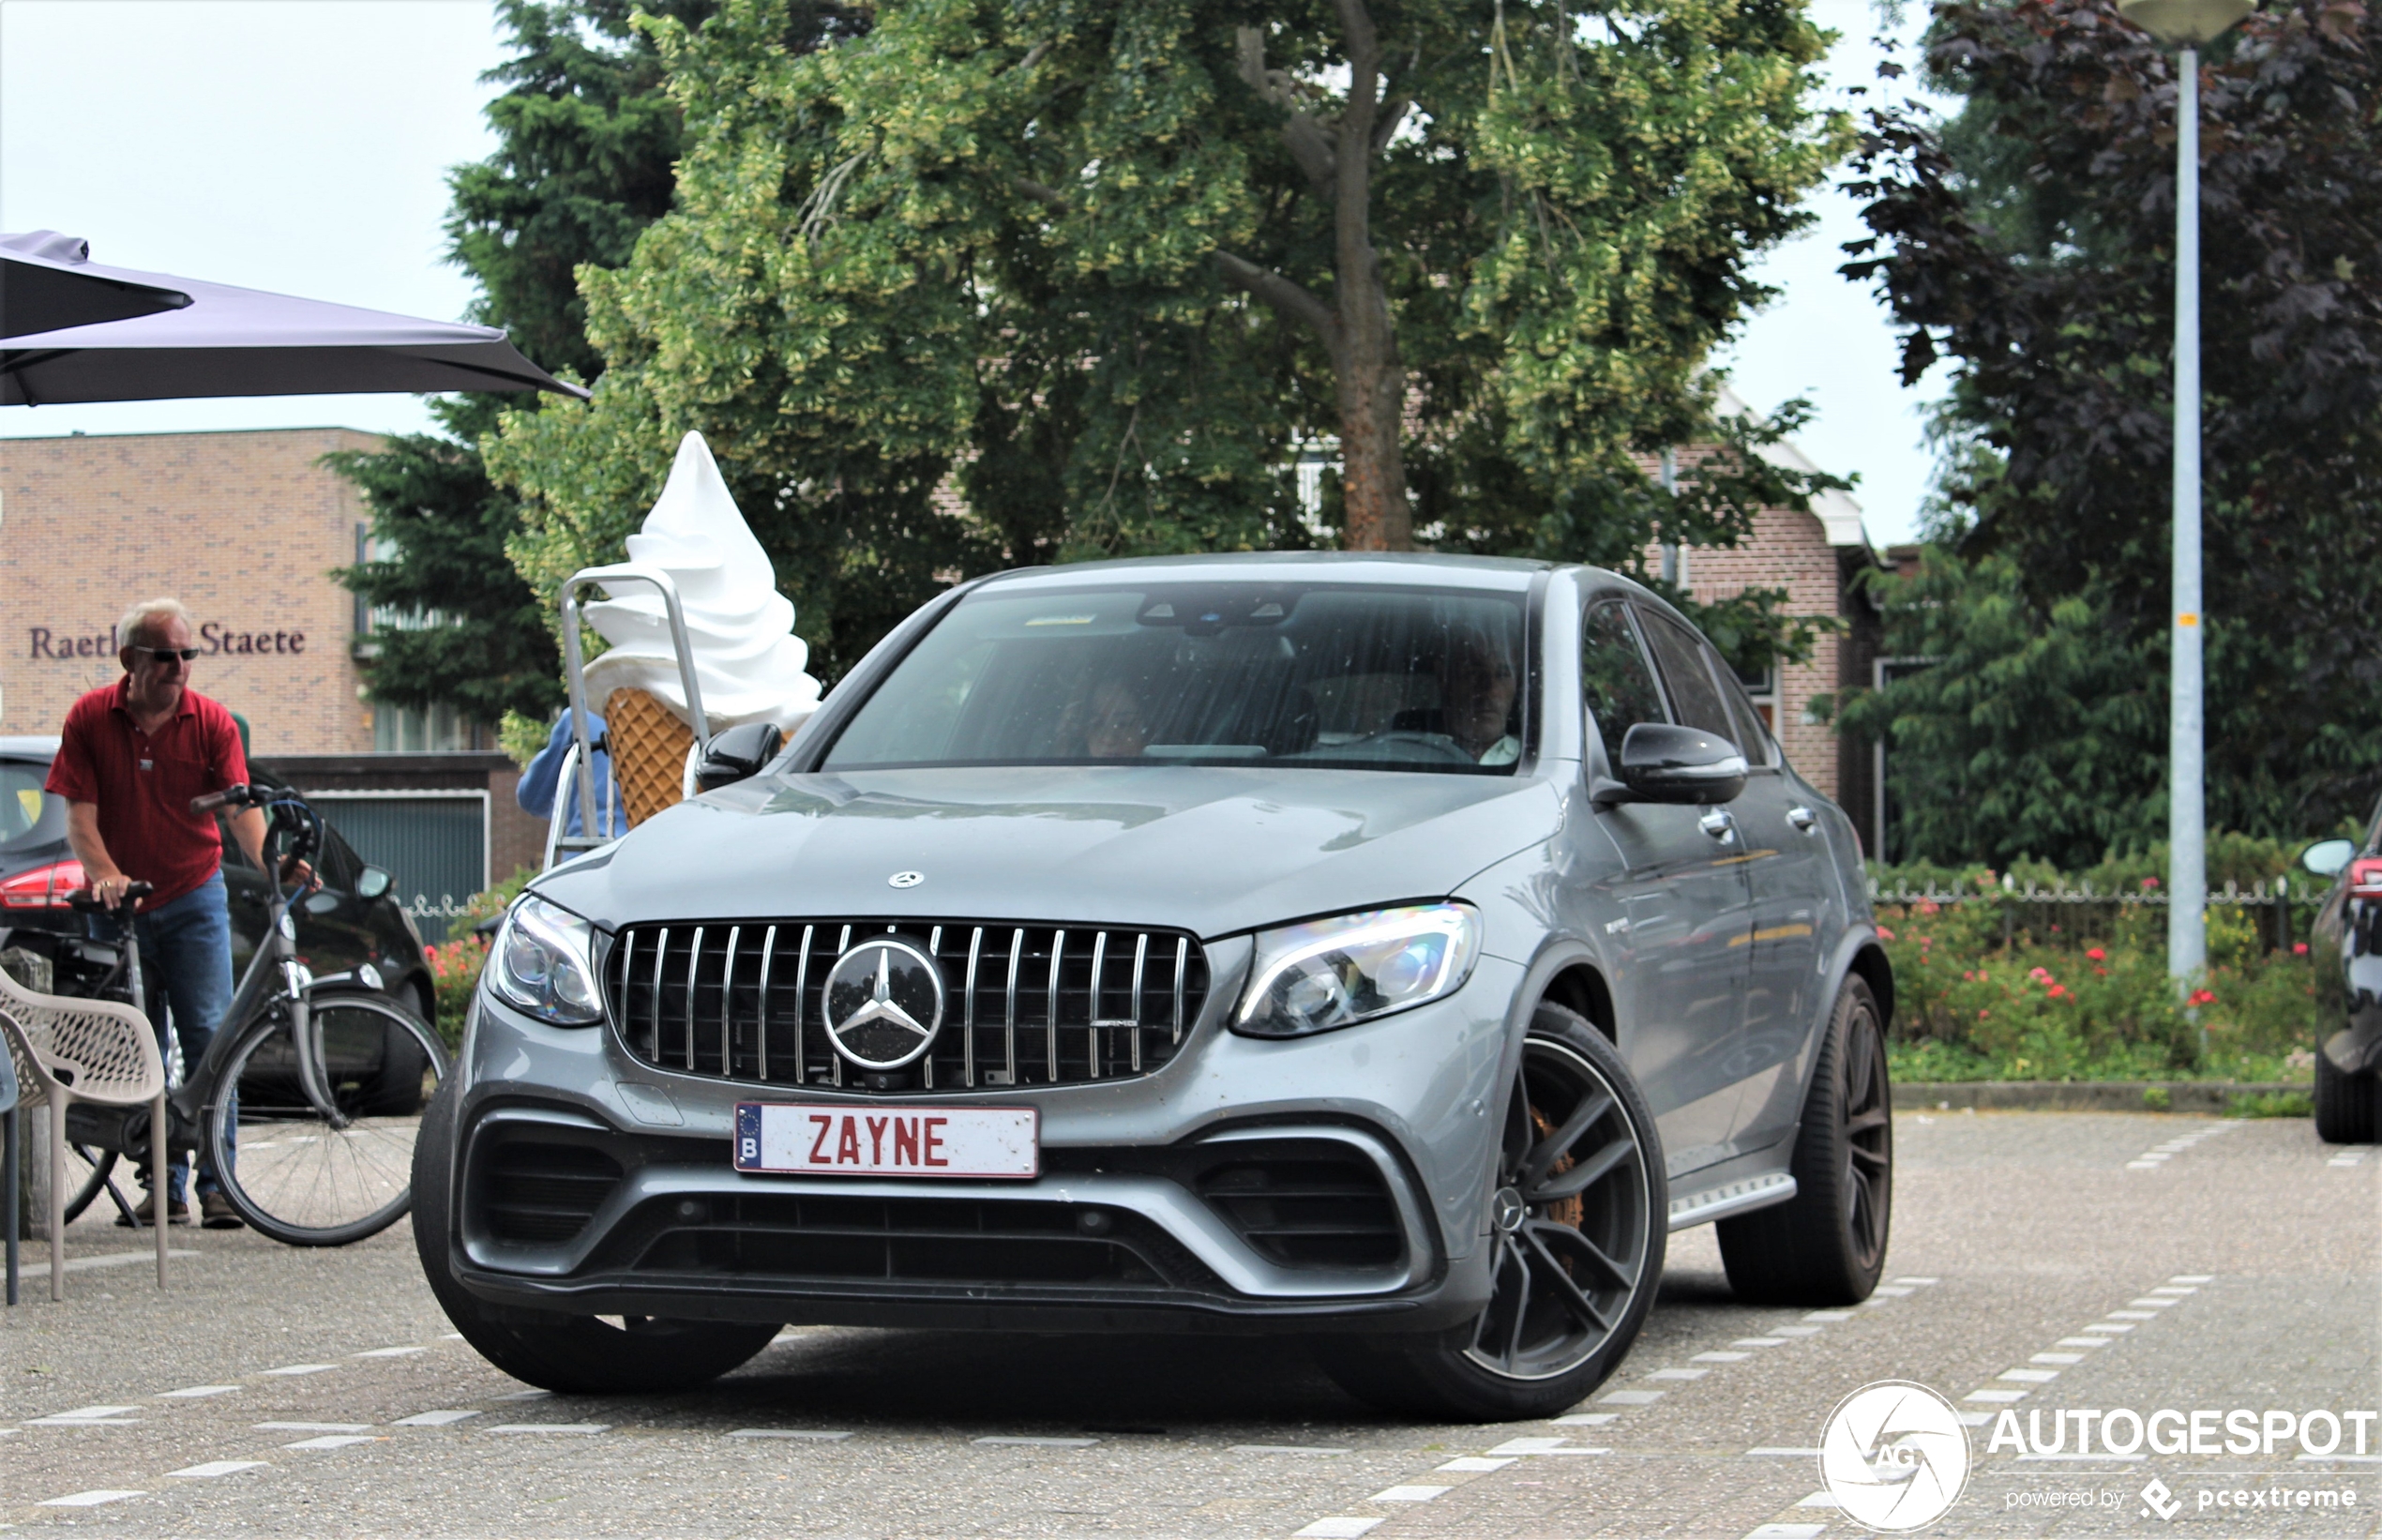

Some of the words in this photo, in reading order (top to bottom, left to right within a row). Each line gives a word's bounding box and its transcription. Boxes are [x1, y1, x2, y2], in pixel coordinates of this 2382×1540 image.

[199, 623, 306, 656] Staete
[741, 1138, 758, 1159] B
[808, 1115, 949, 1167] ZAYNE
